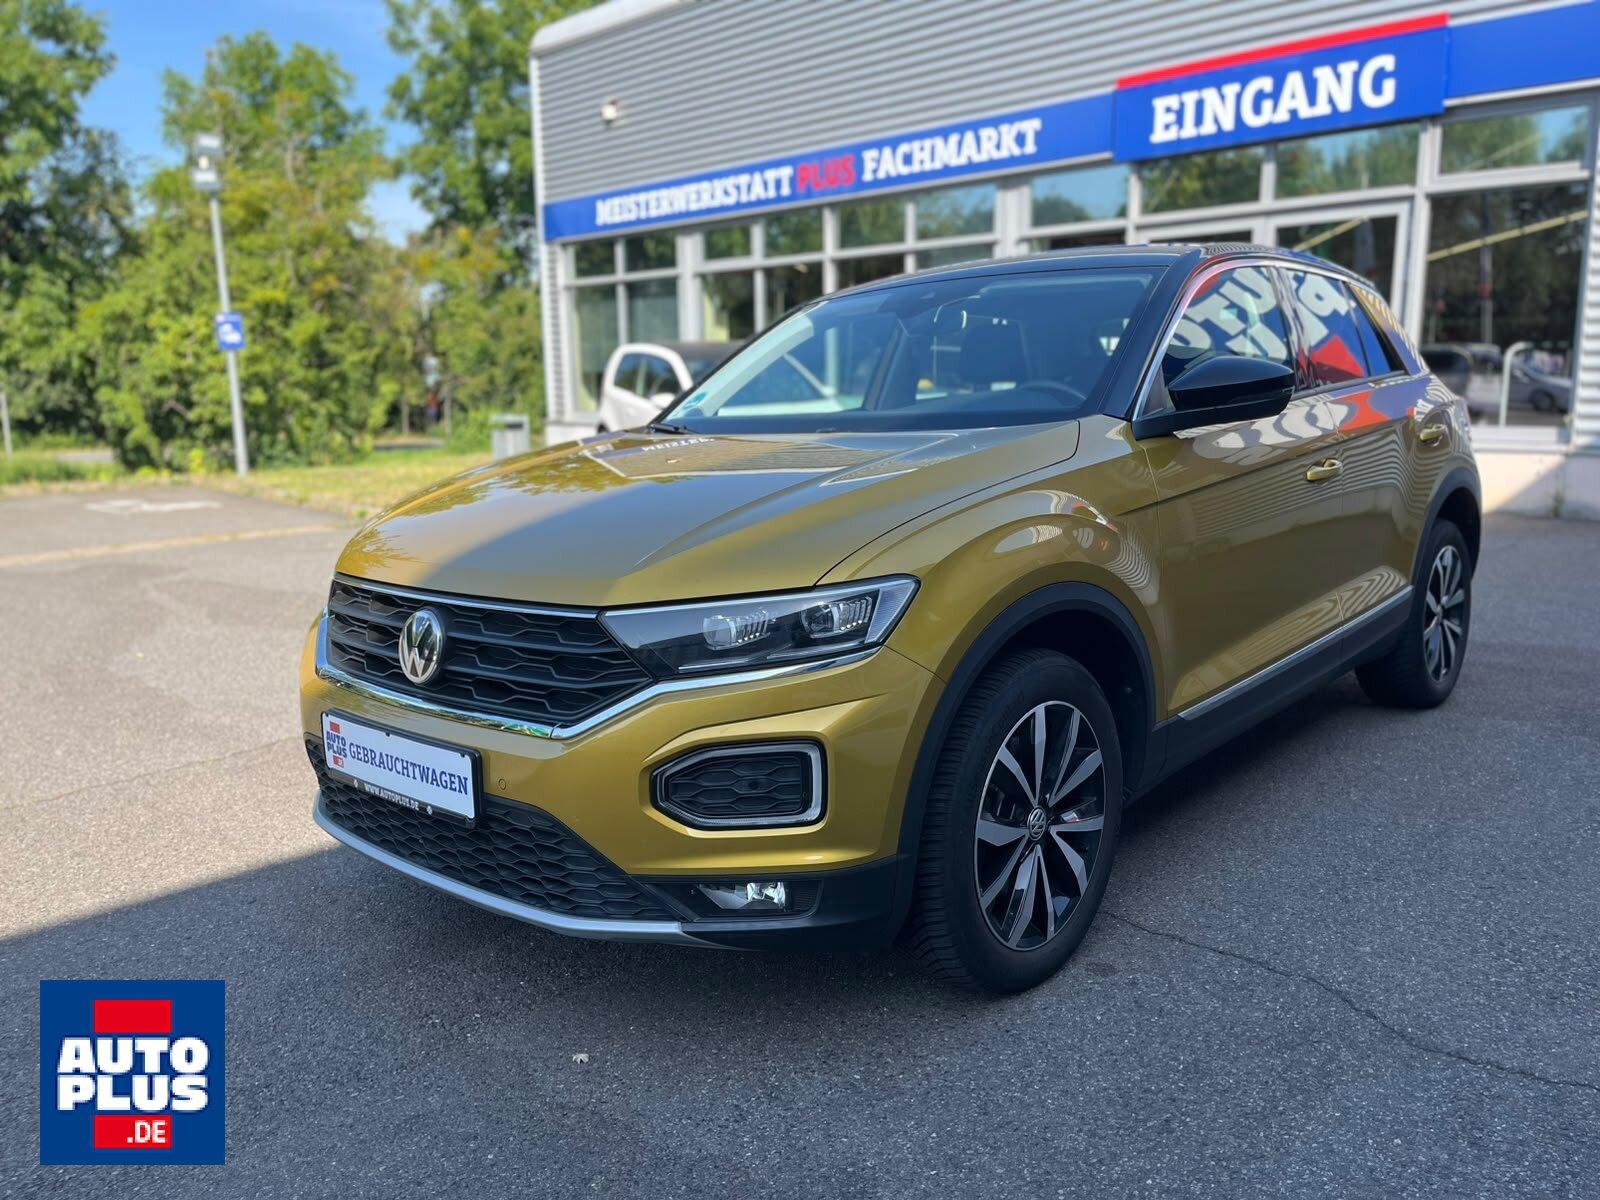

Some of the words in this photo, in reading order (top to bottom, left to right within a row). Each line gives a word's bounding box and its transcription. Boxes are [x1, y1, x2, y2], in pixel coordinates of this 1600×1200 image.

[1149, 53, 1397, 145] EINGANG
[595, 165, 793, 226] MEISTERWERKSTATT
[797, 155, 856, 193] PLUS
[861, 118, 1042, 182] FACHMARKT
[326, 731, 347, 747] AUTO
[327, 741, 348, 759] PLUS
[349, 742, 469, 796] GEBRAUCHTWAGEN
